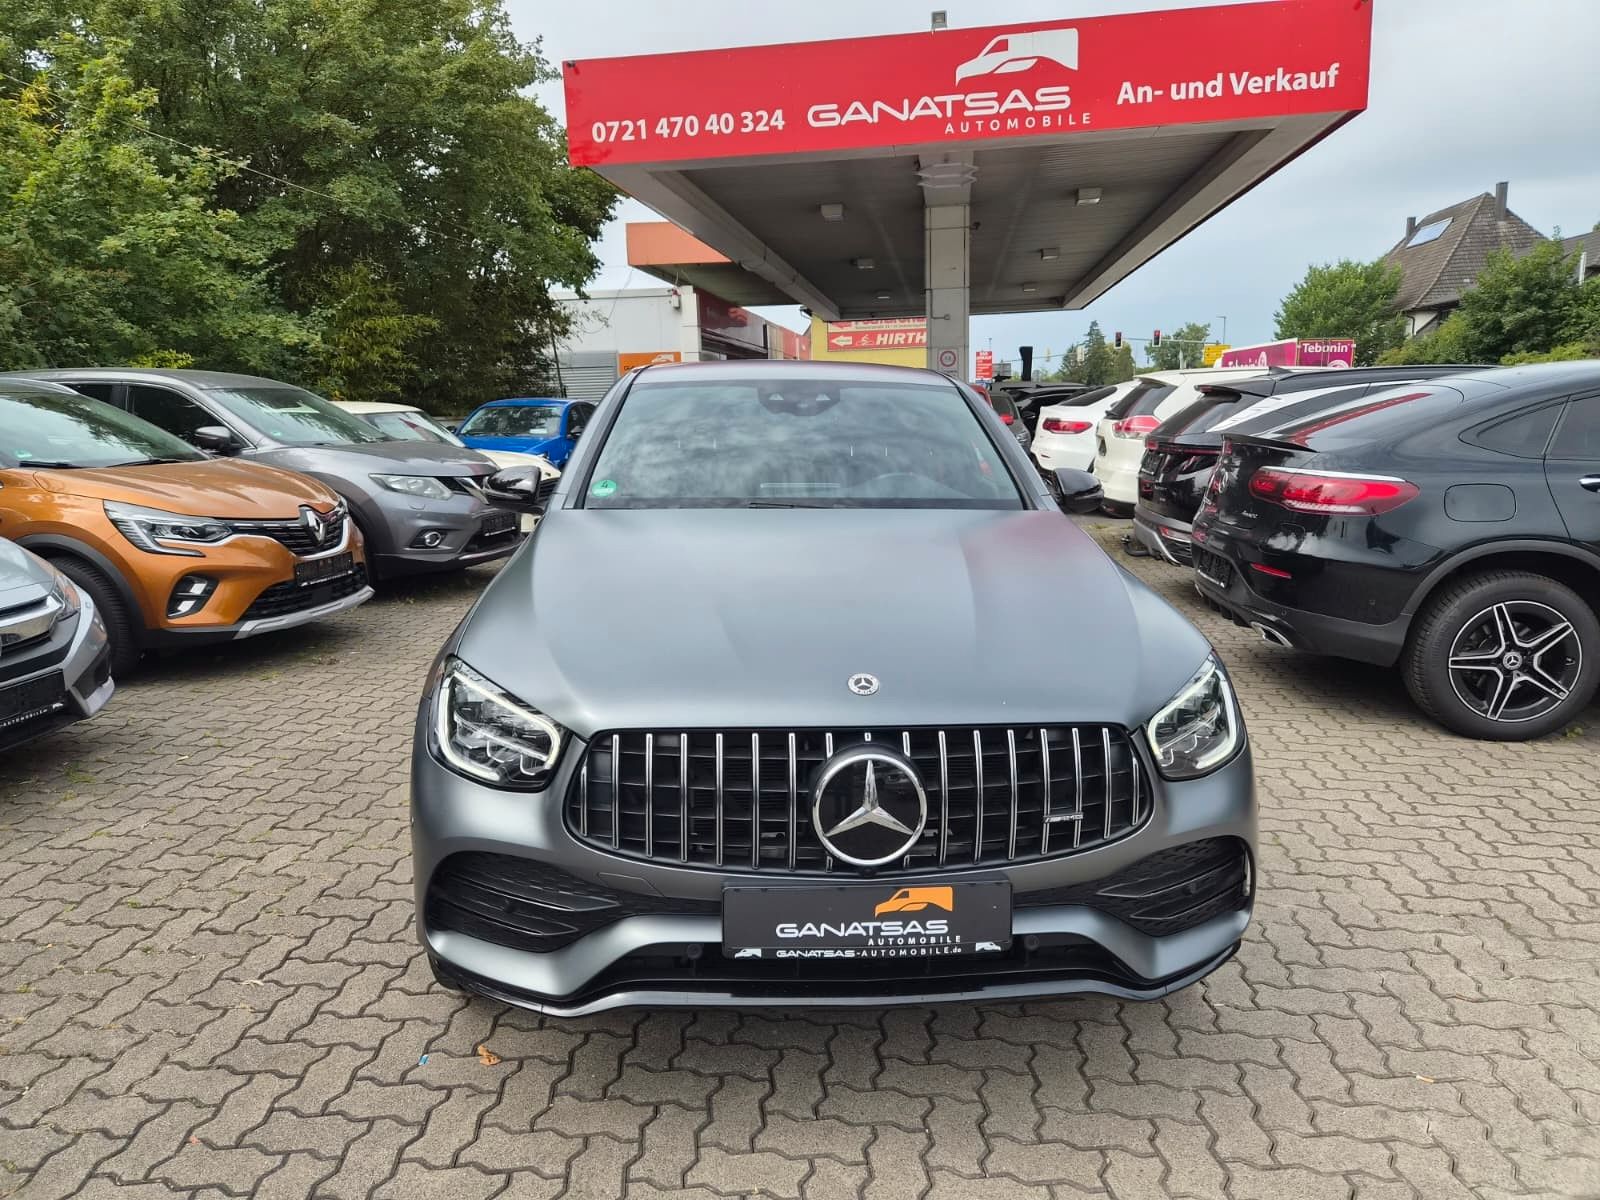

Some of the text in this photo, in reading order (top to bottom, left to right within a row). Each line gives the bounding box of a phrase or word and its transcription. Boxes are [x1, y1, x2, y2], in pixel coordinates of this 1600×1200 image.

[1116, 62, 1341, 105] An- und Verkauf
[806, 85, 1071, 128] GANATSAS
[591, 108, 786, 143] 0721 470 40 324
[944, 112, 1092, 135] AUTOMOBILE
[875, 330, 928, 346] HIRTH
[1302, 342, 1349, 354] Tebonin
[775, 919, 950, 938] GANATSAS
[867, 935, 962, 946] AUTOMOBILE
[775, 946, 963, 959] GANATSAS-AUTOMOBILE.de
